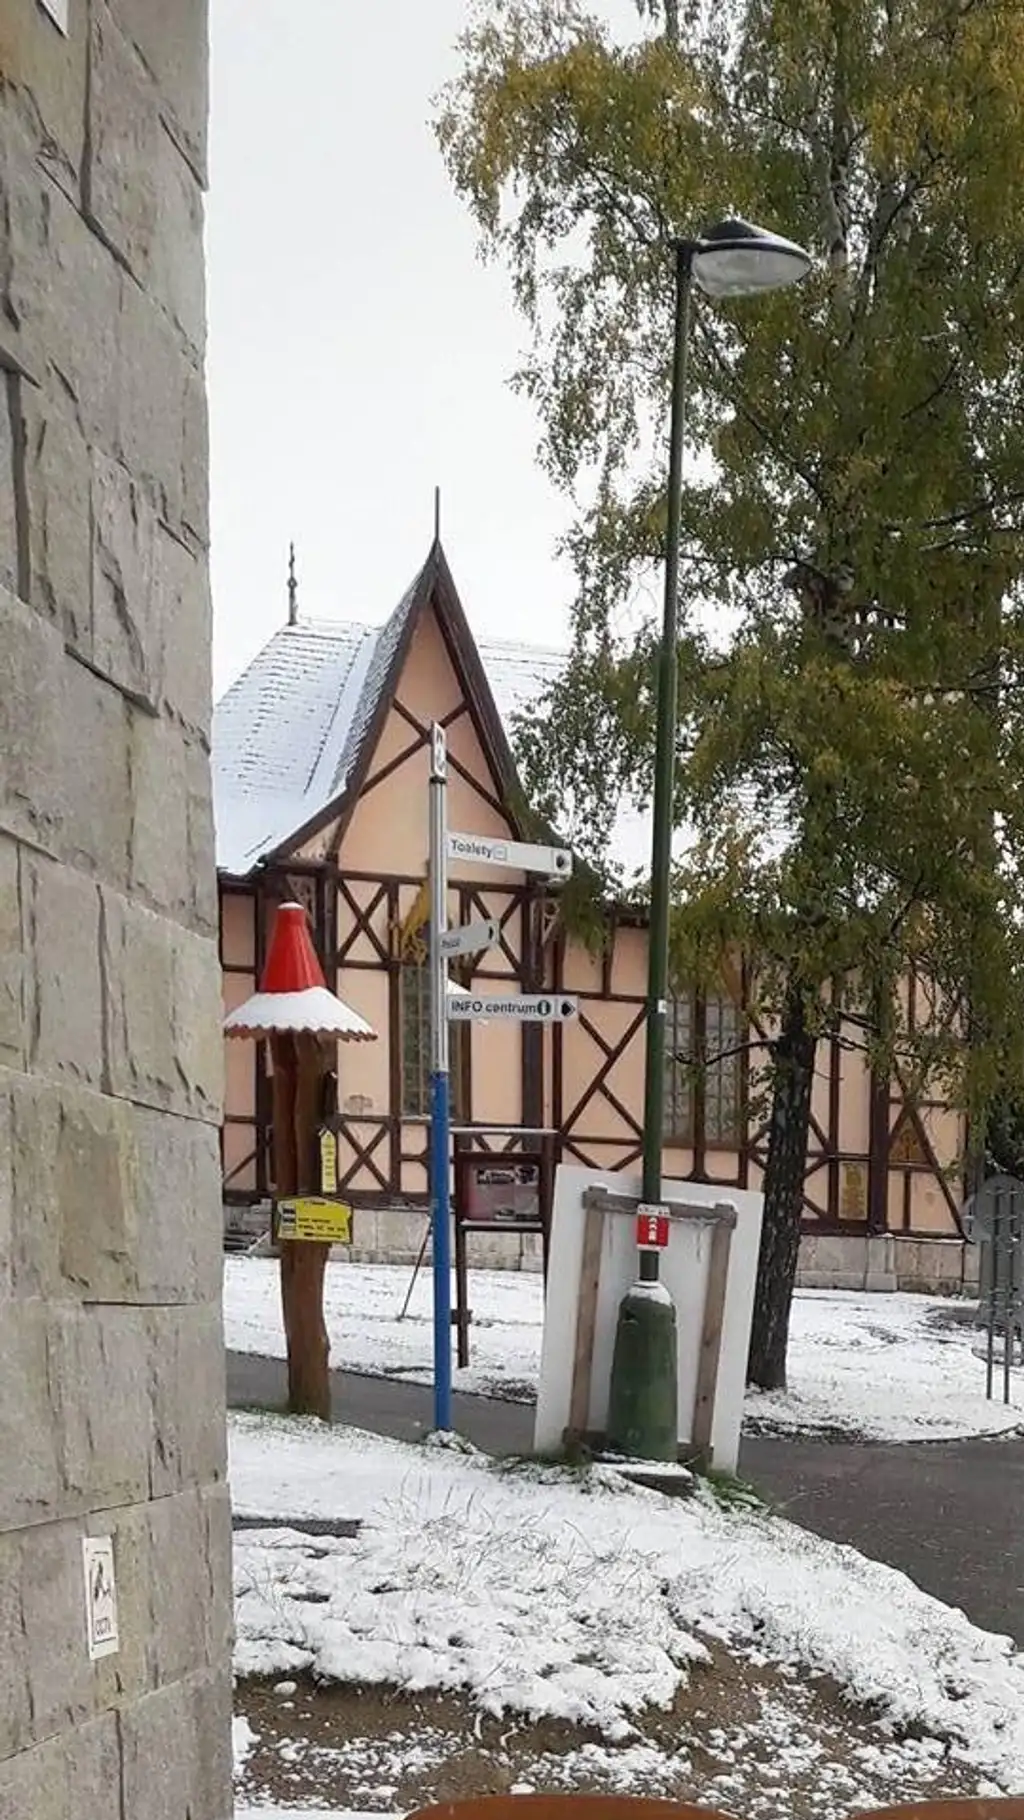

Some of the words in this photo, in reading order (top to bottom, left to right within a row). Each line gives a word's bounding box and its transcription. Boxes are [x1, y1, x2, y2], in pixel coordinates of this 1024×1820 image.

[451, 839, 491, 858] Toalety
[451, 1001, 482, 1012] INFO
[485, 1002, 536, 1013] centrum
